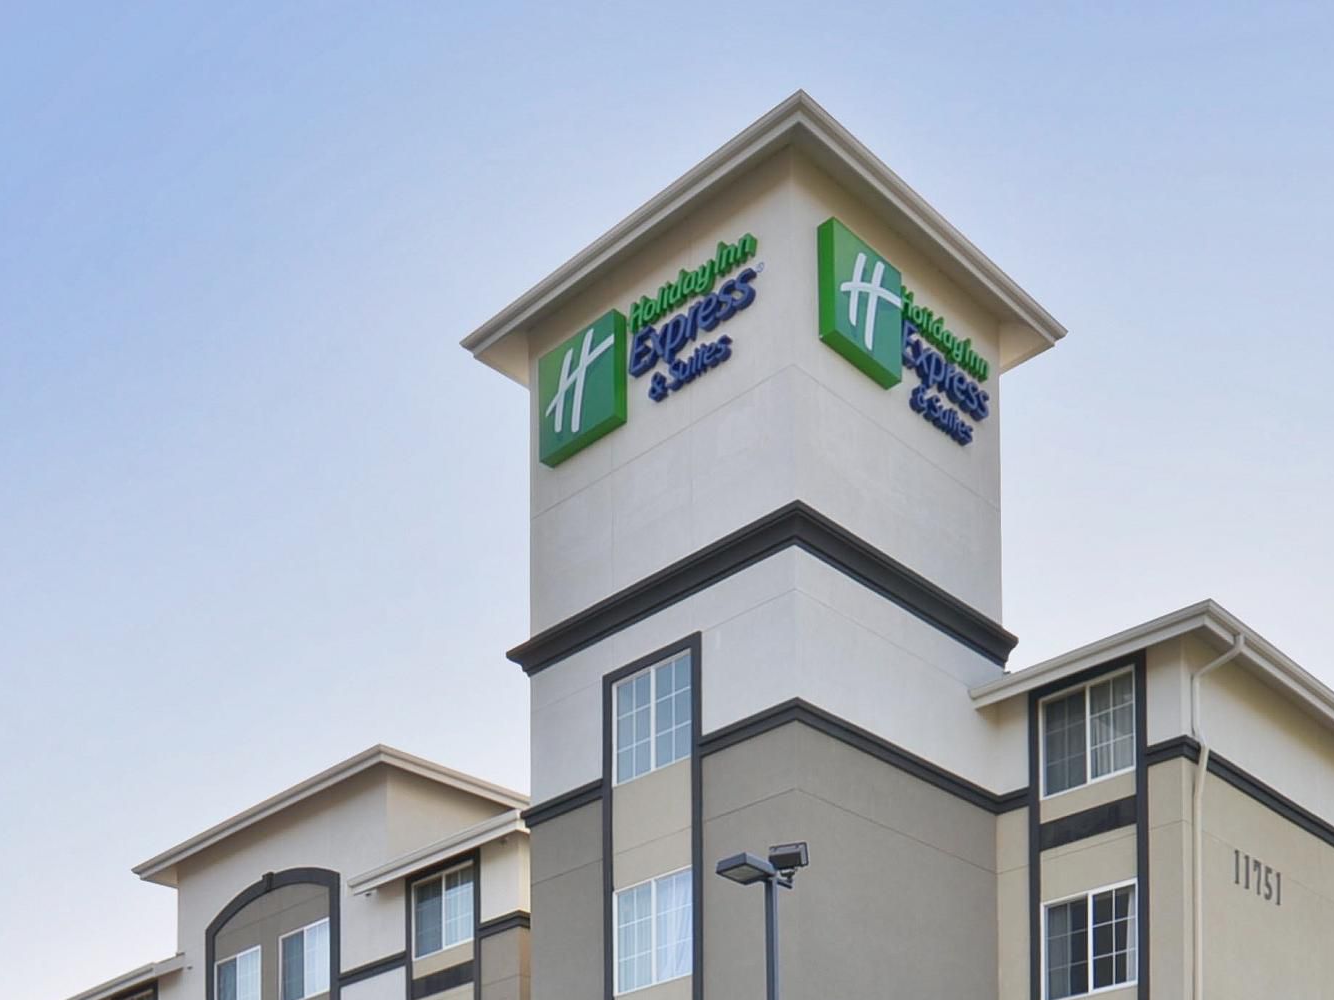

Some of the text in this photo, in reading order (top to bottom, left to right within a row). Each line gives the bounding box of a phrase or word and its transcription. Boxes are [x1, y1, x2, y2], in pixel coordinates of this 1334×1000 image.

[629, 233, 757, 333] Holiday Inn
[629, 267, 757, 378] Express
[648, 335, 733, 402] & Suites
[901, 285, 989, 383] Holiday Inn
[901, 320, 989, 421] Express
[911, 383, 973, 446] & Suites
[1234, 849, 1281, 906] 11751
